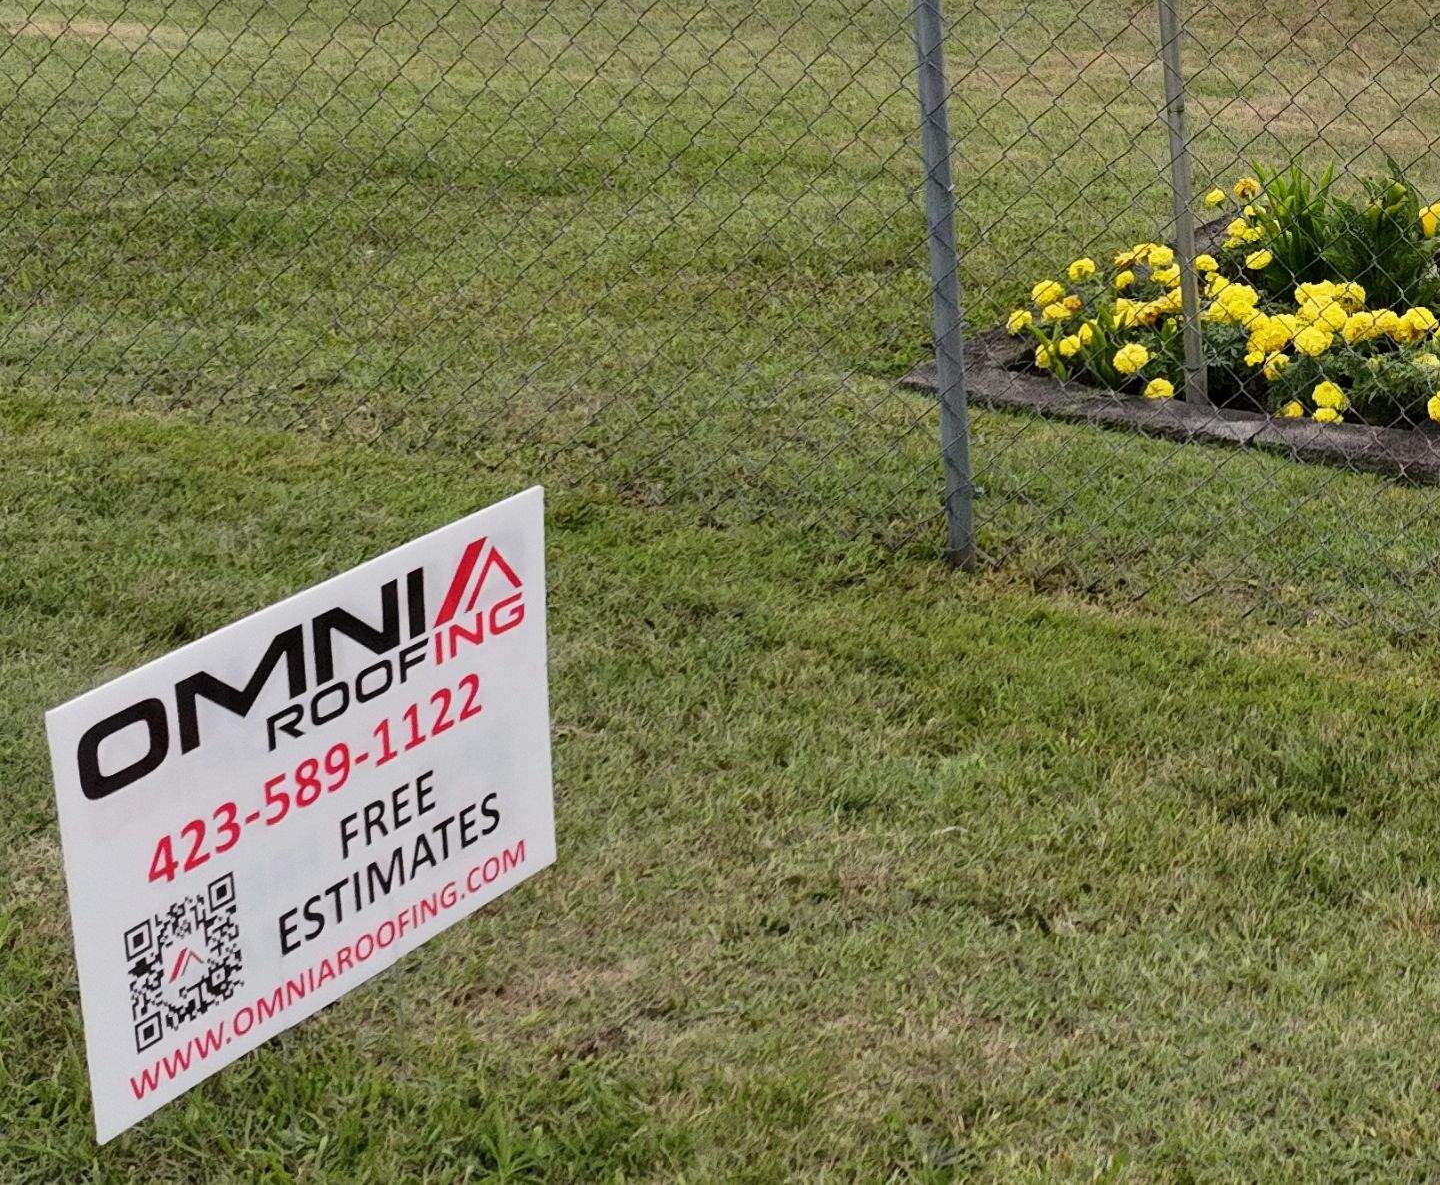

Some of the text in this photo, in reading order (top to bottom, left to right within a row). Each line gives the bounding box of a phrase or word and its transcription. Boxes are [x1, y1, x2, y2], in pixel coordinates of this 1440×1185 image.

[76, 535, 523, 801] OMNIA
[265, 591, 527, 752] ROOFING
[147, 673, 483, 885] 423-589-1122
[340, 770, 436, 858] FREE
[278, 792, 501, 954] ESTIMATES
[130, 839, 527, 1101] WWW.OMNIAROOFING.COM
